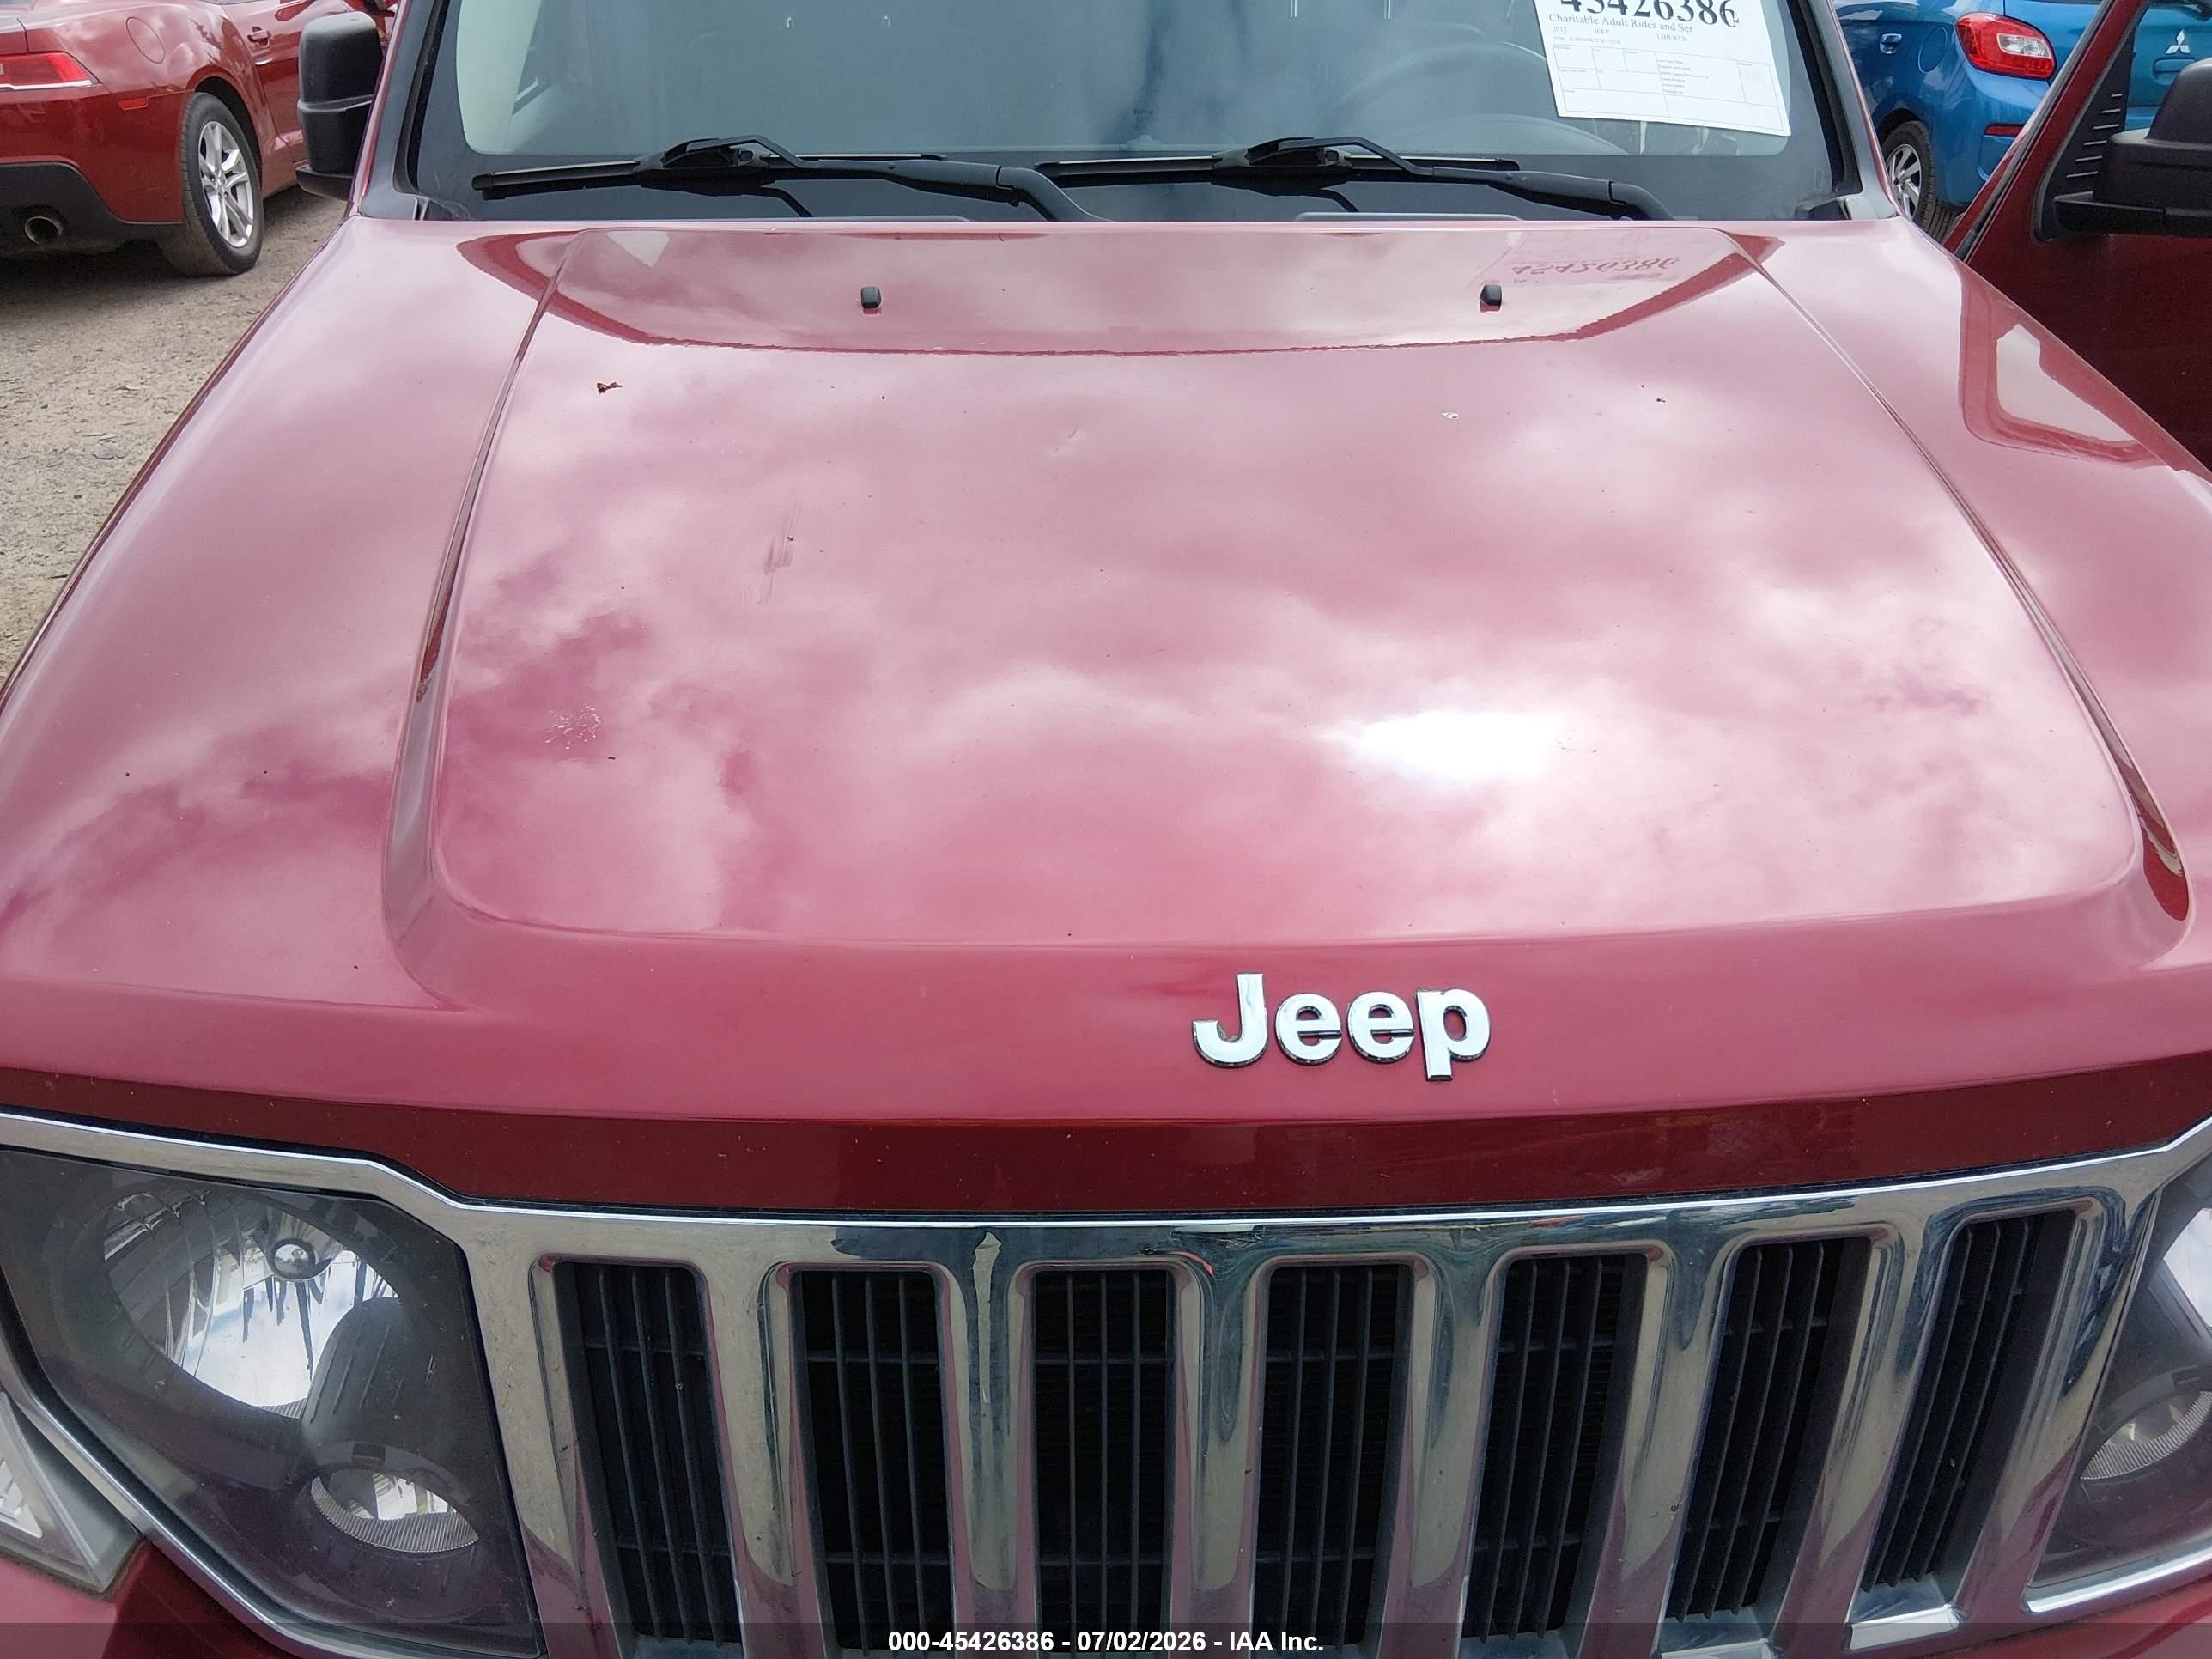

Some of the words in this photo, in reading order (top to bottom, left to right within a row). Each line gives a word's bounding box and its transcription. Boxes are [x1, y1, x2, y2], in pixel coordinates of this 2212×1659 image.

[1548, 13, 1599, 26] Charitable
[1601, 17, 1629, 27] Adult
[1631, 19, 1657, 30] Rides
[1659, 22, 1676, 33] and
[1193, 972, 1491, 1082] Jeep
